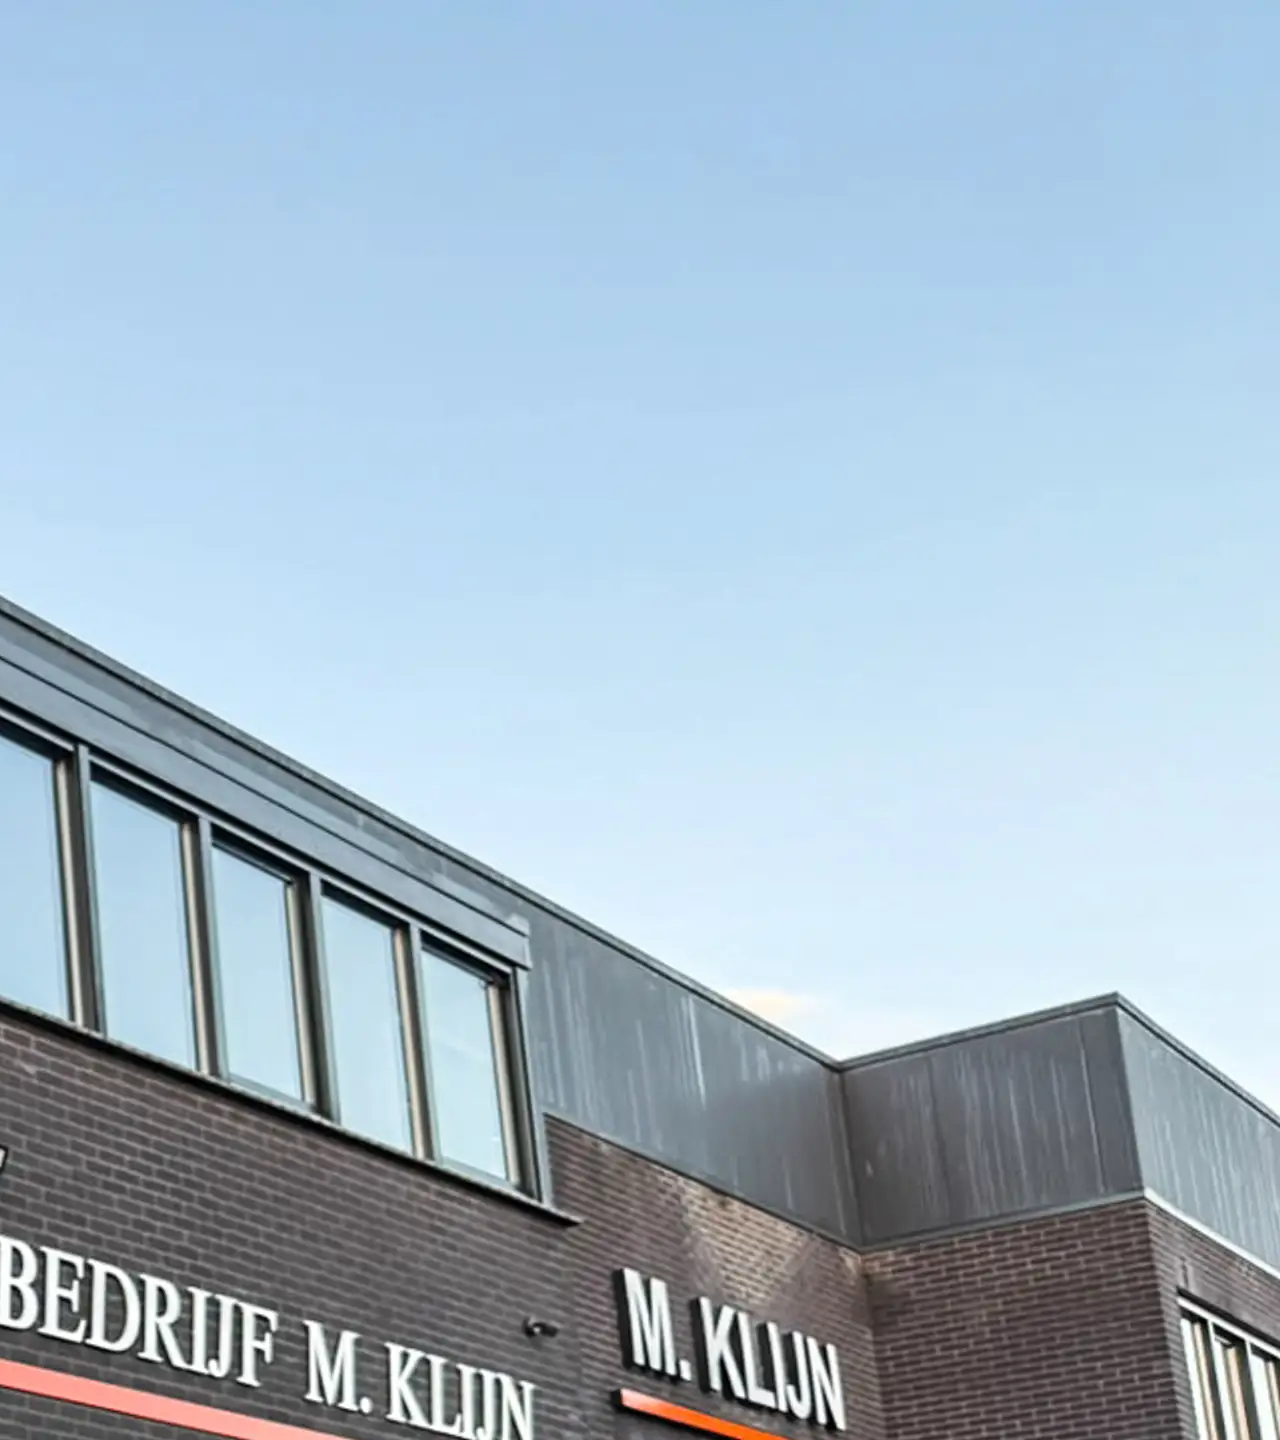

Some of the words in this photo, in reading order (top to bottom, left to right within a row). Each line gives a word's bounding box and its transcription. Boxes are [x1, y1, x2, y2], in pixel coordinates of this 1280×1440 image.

[303, 1320, 373, 1414] M.
[622, 1267, 692, 1381] M.
[698, 1296, 847, 1432] KLIJN
